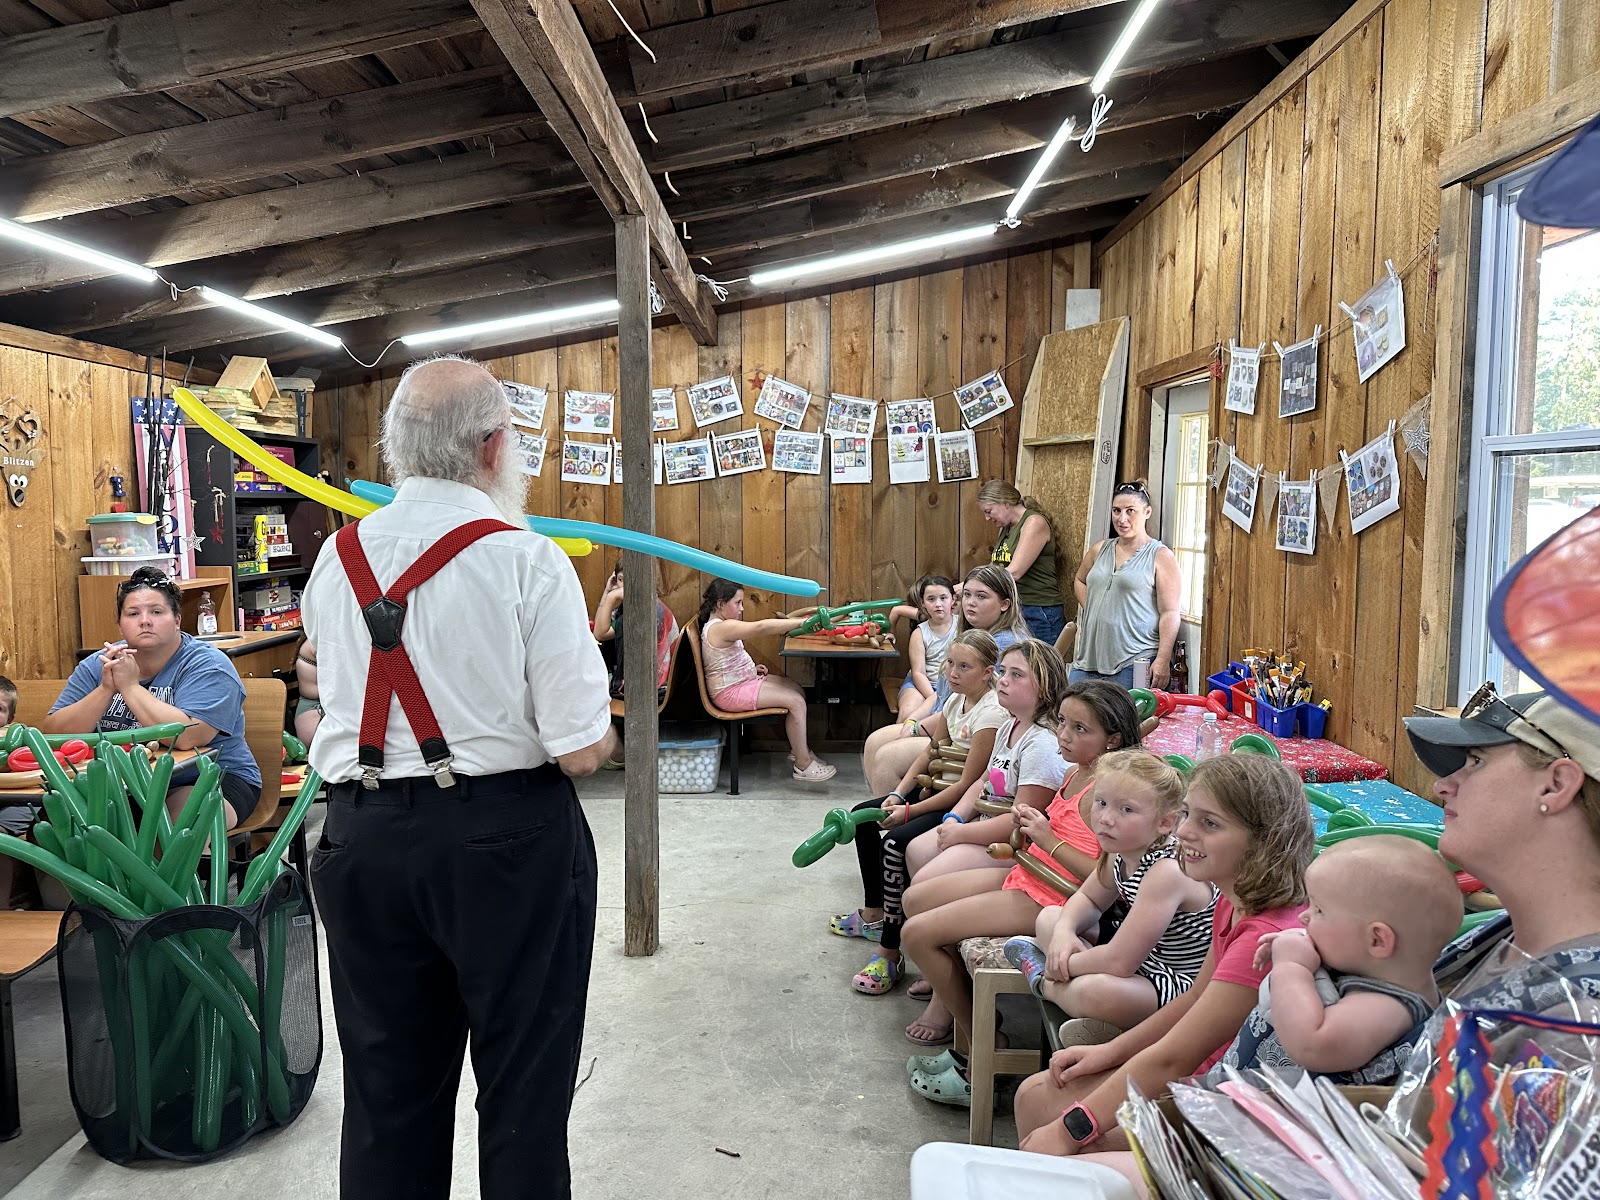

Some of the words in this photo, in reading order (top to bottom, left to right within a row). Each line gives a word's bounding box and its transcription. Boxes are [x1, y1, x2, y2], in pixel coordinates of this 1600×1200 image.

[3, 456, 35, 466] Blitzen
[272, 544, 291, 553] SEQUENCE
[882, 838, 905, 925] JUSTICE
